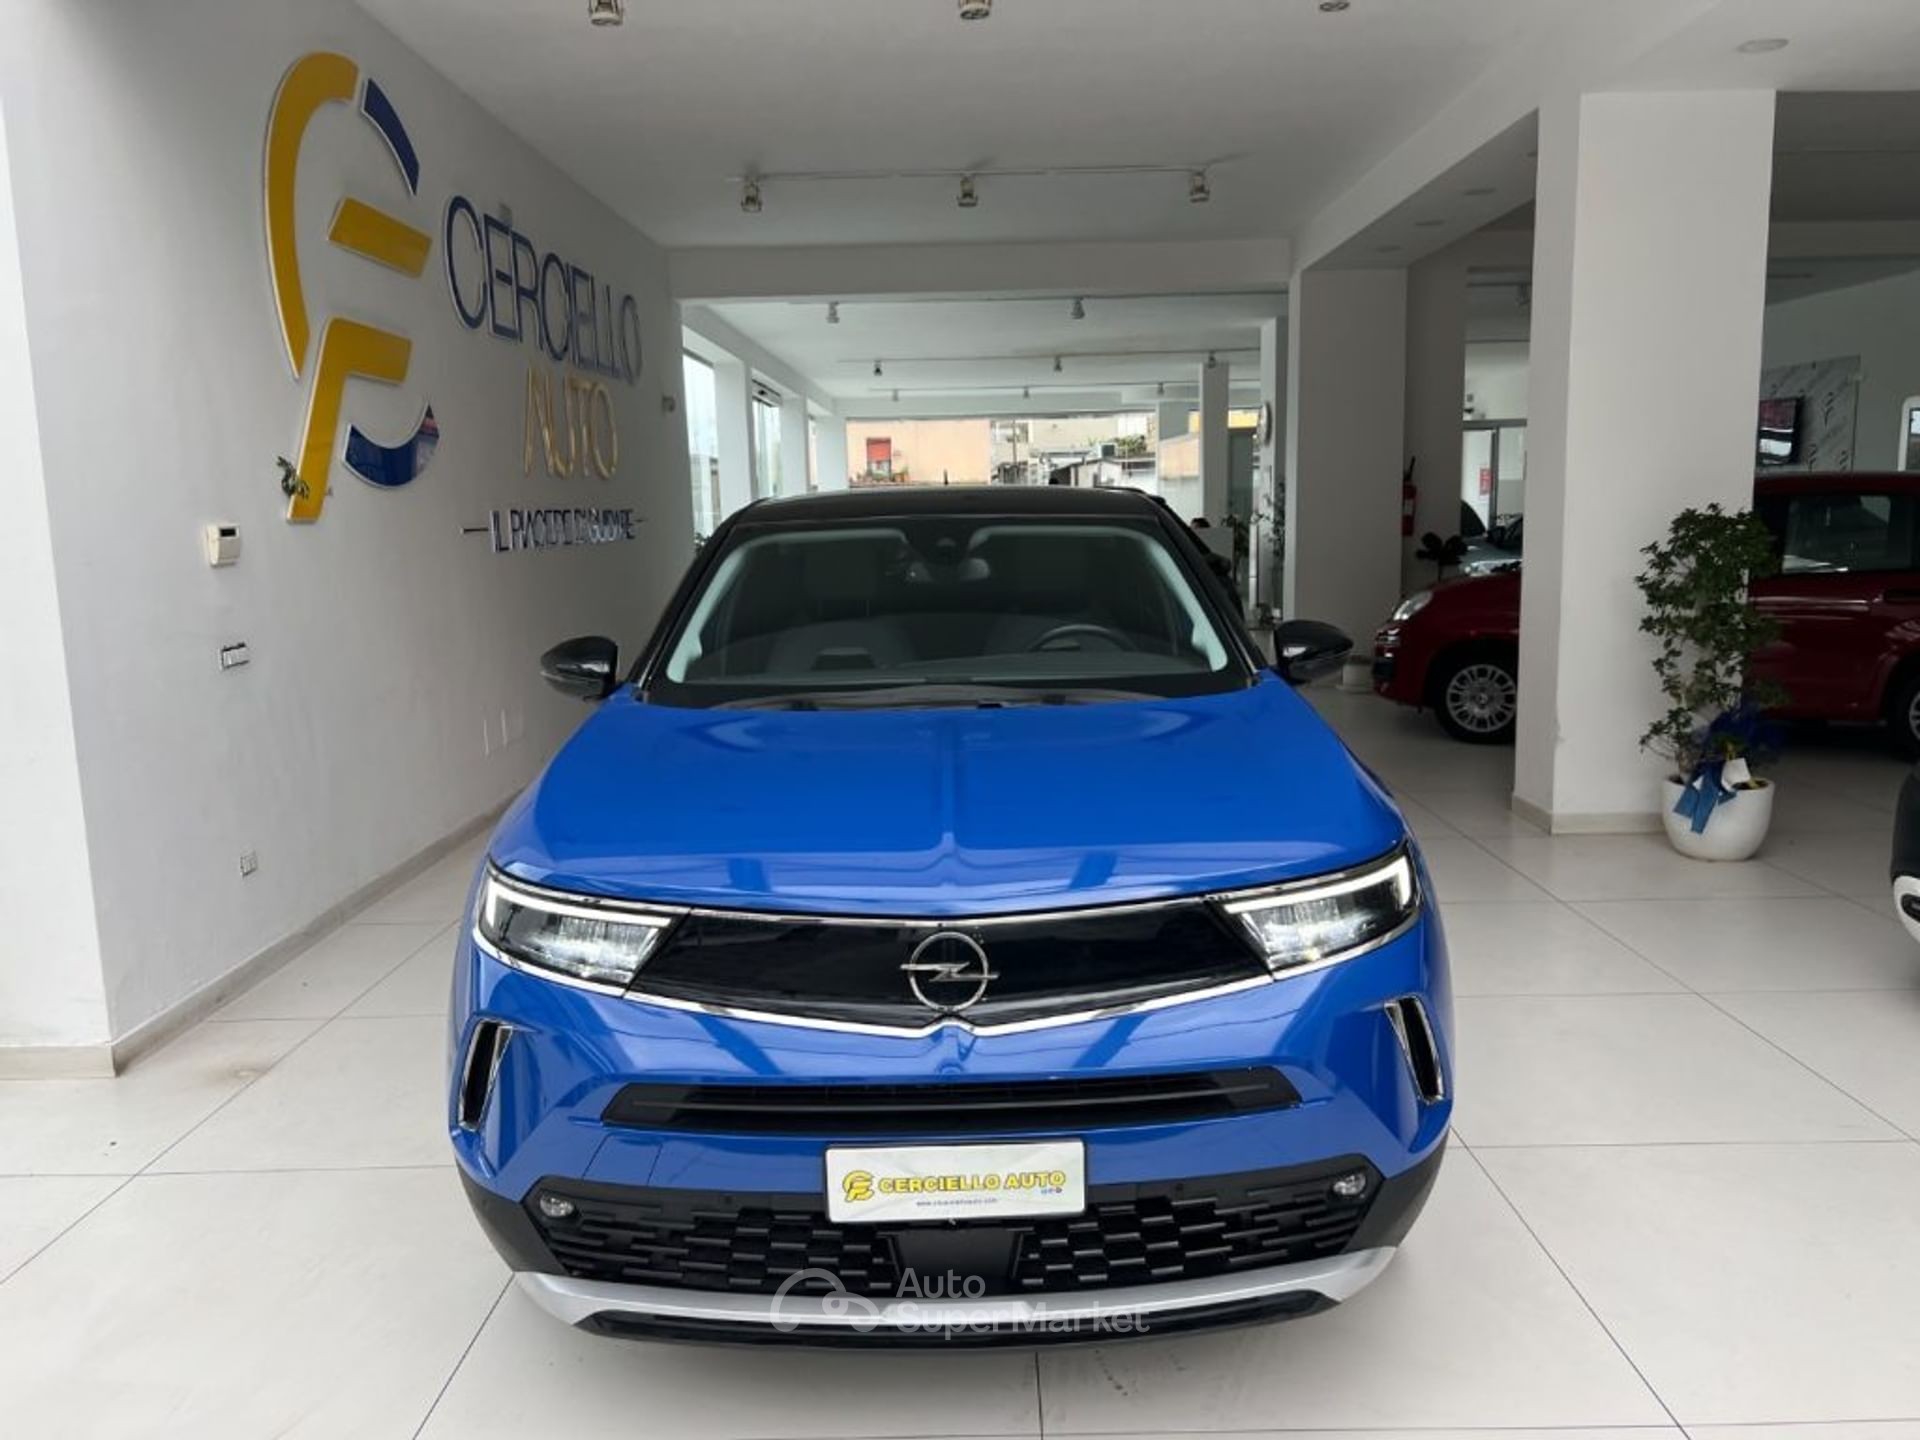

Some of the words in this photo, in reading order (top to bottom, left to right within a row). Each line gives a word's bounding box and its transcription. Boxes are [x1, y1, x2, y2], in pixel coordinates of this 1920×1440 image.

[445, 195, 643, 385] CERCIELLO
[878, 1175, 1001, 1194] CERCIELLO
[1003, 1170, 1067, 1190] AUTO
